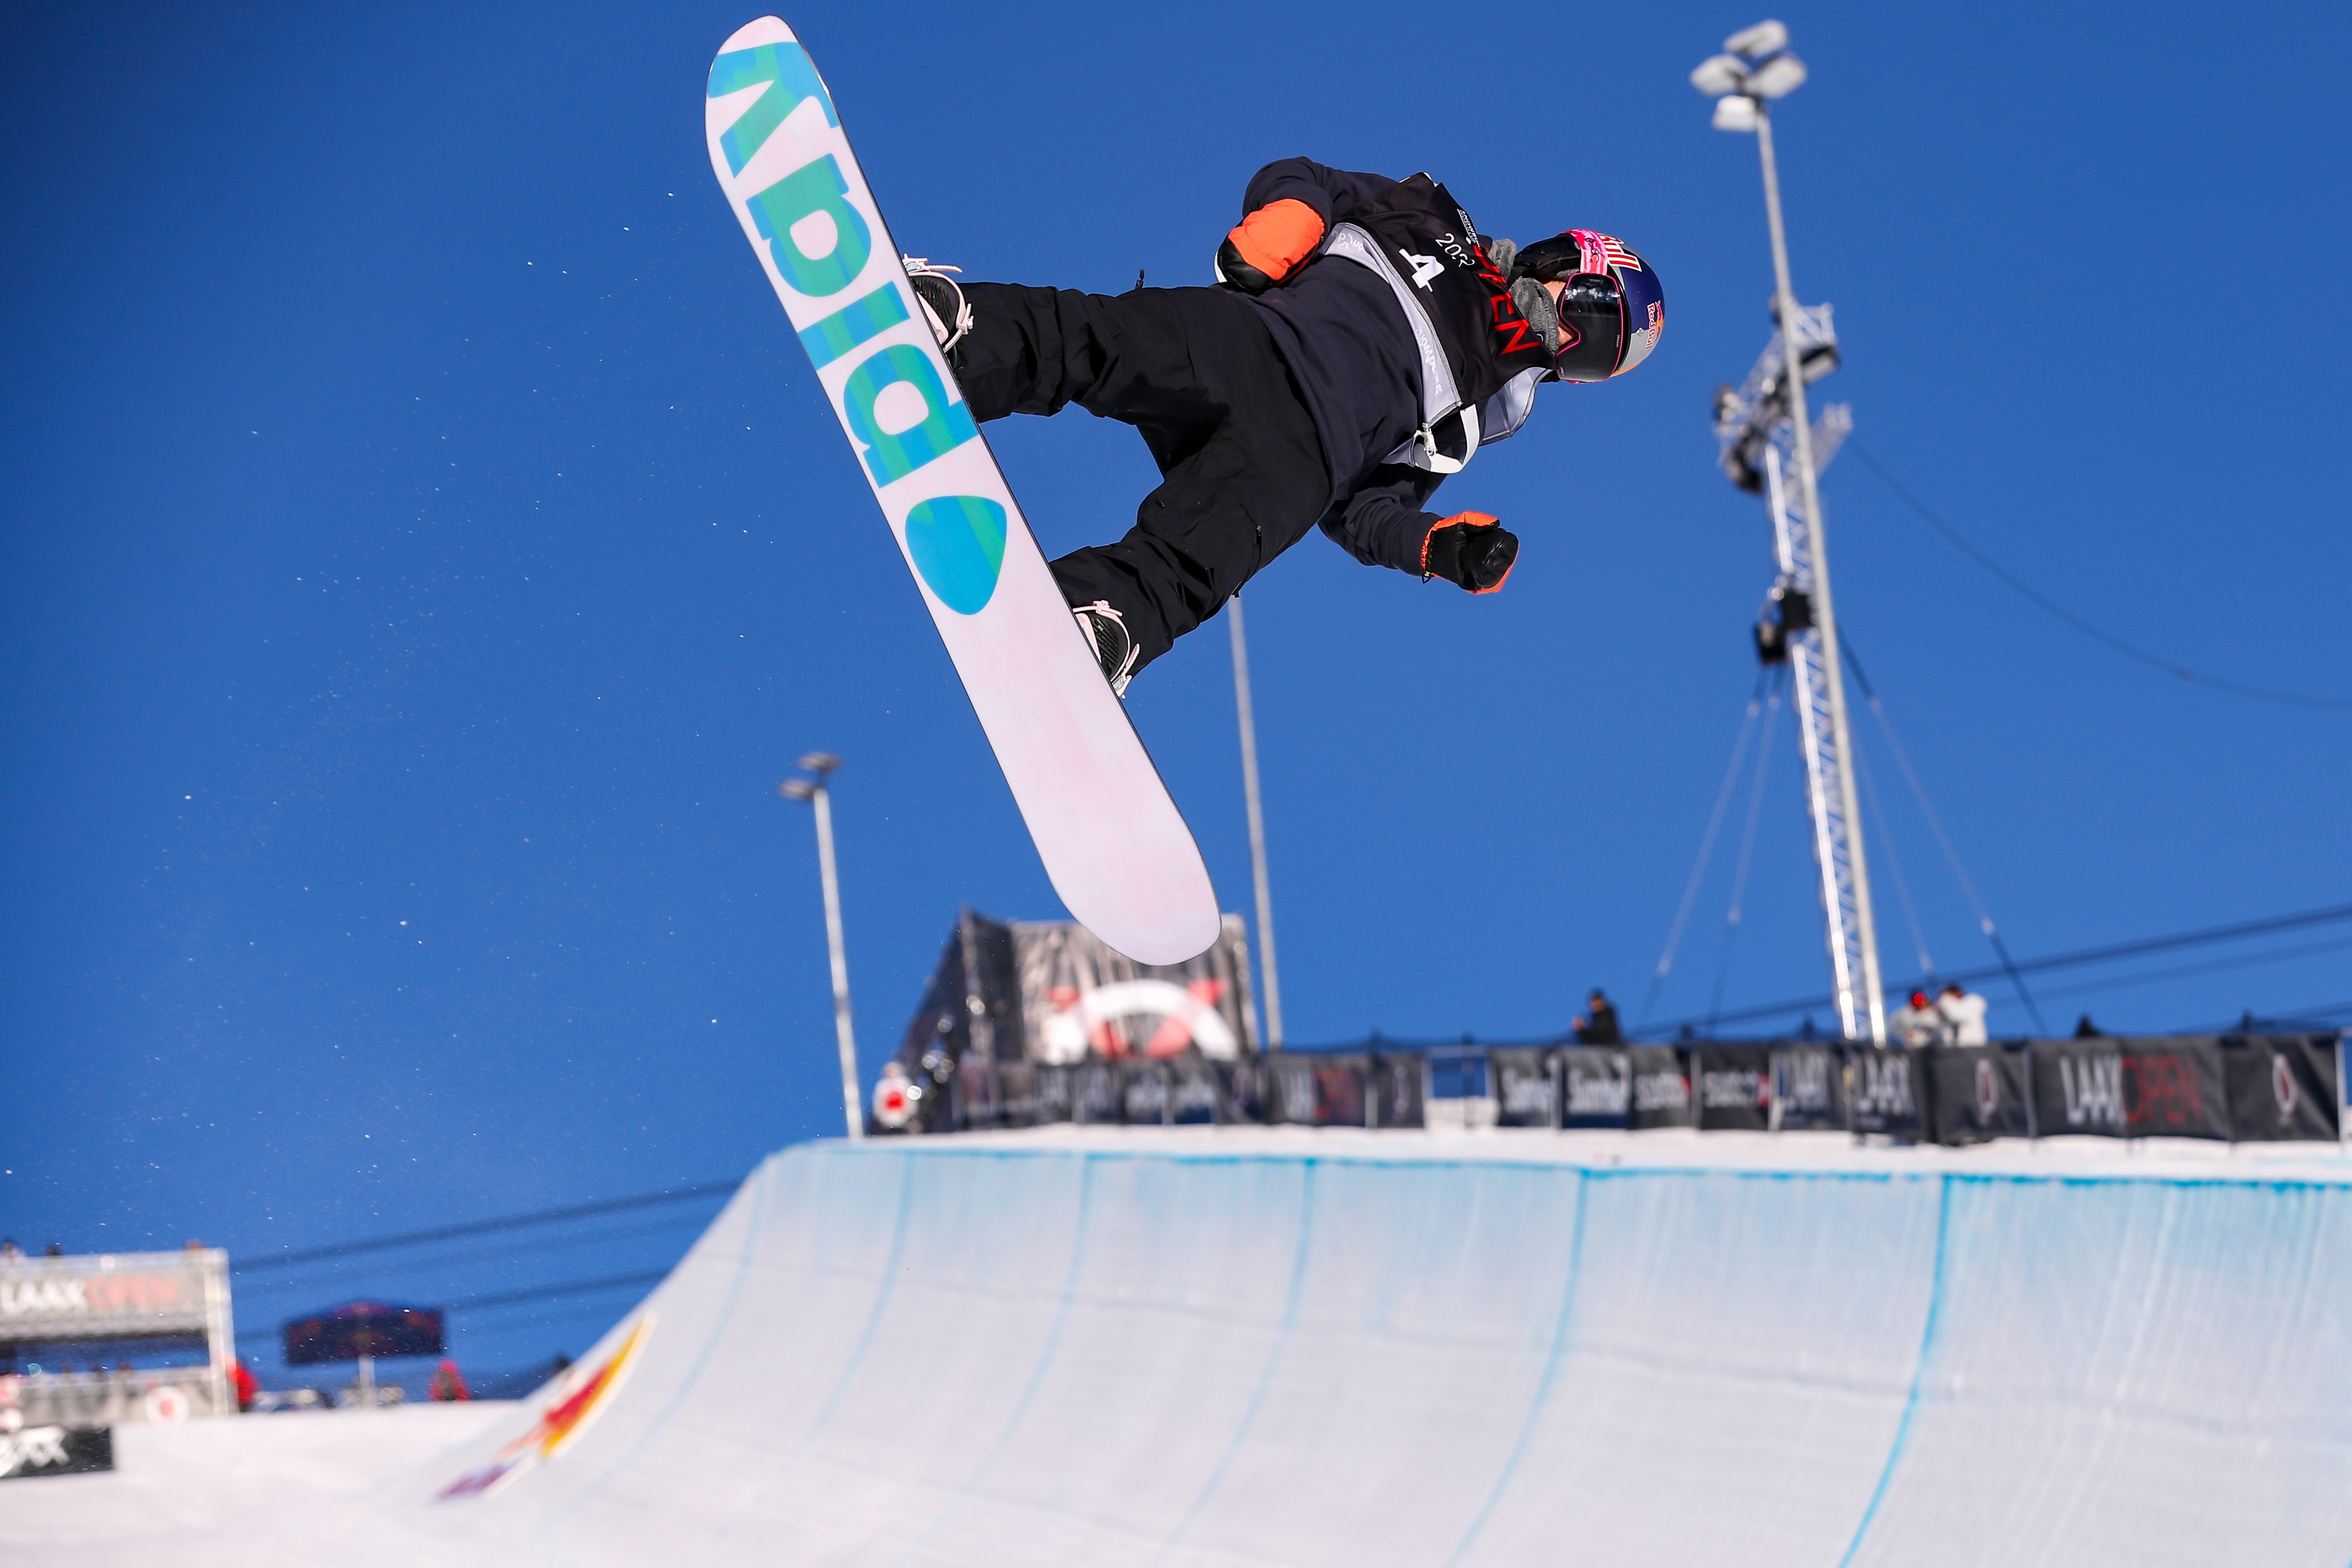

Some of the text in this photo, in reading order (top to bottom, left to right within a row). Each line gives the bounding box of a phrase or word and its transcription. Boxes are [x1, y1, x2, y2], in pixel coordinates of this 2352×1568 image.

[708, 42, 980, 489] play
[1399, 248, 1445, 293] 4
[1645, 302, 1657, 349] Red Bull
